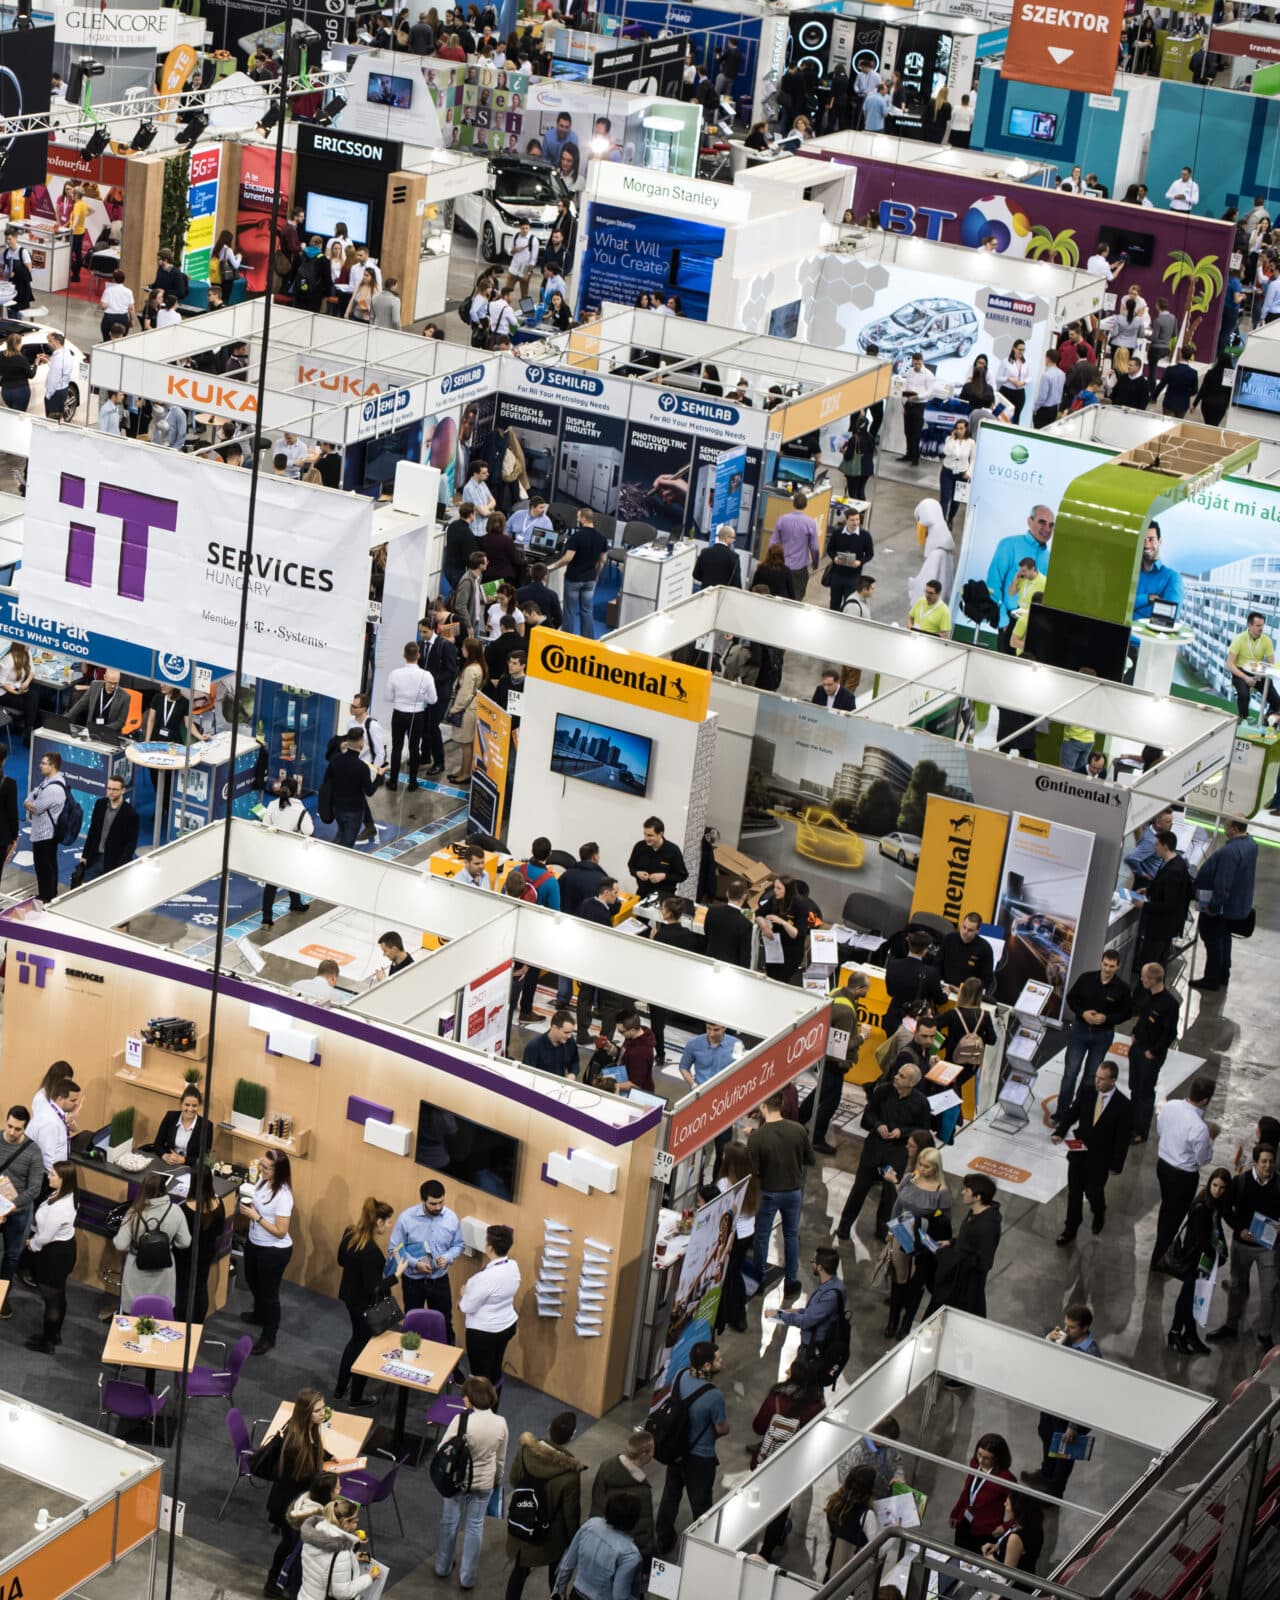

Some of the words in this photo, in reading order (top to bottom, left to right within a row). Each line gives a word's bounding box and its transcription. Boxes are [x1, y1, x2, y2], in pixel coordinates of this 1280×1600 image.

[66, 11, 168, 33] GLENCORE
[1021, 4, 1109, 34] SZEKTOR
[949, 40, 961, 88] HARMAN
[314, 135, 383, 161] ERICSSON
[192, 160, 207, 178] 5G
[244, 172, 251, 180] A
[623, 176, 669, 198] Morgan
[672, 186, 719, 209] Stanley
[879, 200, 957, 242] BT
[595, 232, 629, 251] What
[635, 239, 660, 258] Will
[593, 247, 616, 265] You
[621, 253, 670, 275] Create?
[297, 365, 381, 397] KUKA
[548, 374, 597, 393] SEMILAB
[168, 375, 259, 412] KUKA
[501, 402, 537, 417] RESEARCH
[590, 399, 610, 411] Needs
[681, 401, 732, 422] SEMILAB
[500, 410, 552, 428] DEVELOPMENT
[566, 416, 597, 429] DISPLAY
[565, 424, 601, 439] INDUSTRY
[632, 431, 687, 450] PHOTOVOLTAIC
[689, 421, 724, 438] Metrology
[725, 429, 746, 441] Needs
[631, 439, 668, 454] INDUSTRY
[989, 465, 1044, 486] evosoft
[1234, 501, 1257, 517] mi
[207, 542, 334, 593] SERVICES
[205, 568, 271, 598] HUNGARY
[8, 601, 52, 630] Tetra
[202, 609, 237, 629] Member
[26, 629, 60, 647] WHAT'S
[62, 641, 89, 656] GOOD
[199, 668, 211, 679] E13
[540, 644, 667, 697] Continental
[1035, 775, 1110, 805] Continental
[65, 968, 105, 983] SERVICES
[833, 1030, 848, 1042] F11
[673, 1113, 708, 1148] Loxon
[711, 1079, 757, 1122] Solutions
[759, 1059, 775, 1088] Zrt.
[657, 1151, 673, 1165] E10
[653, 1560, 665, 1573] F6
